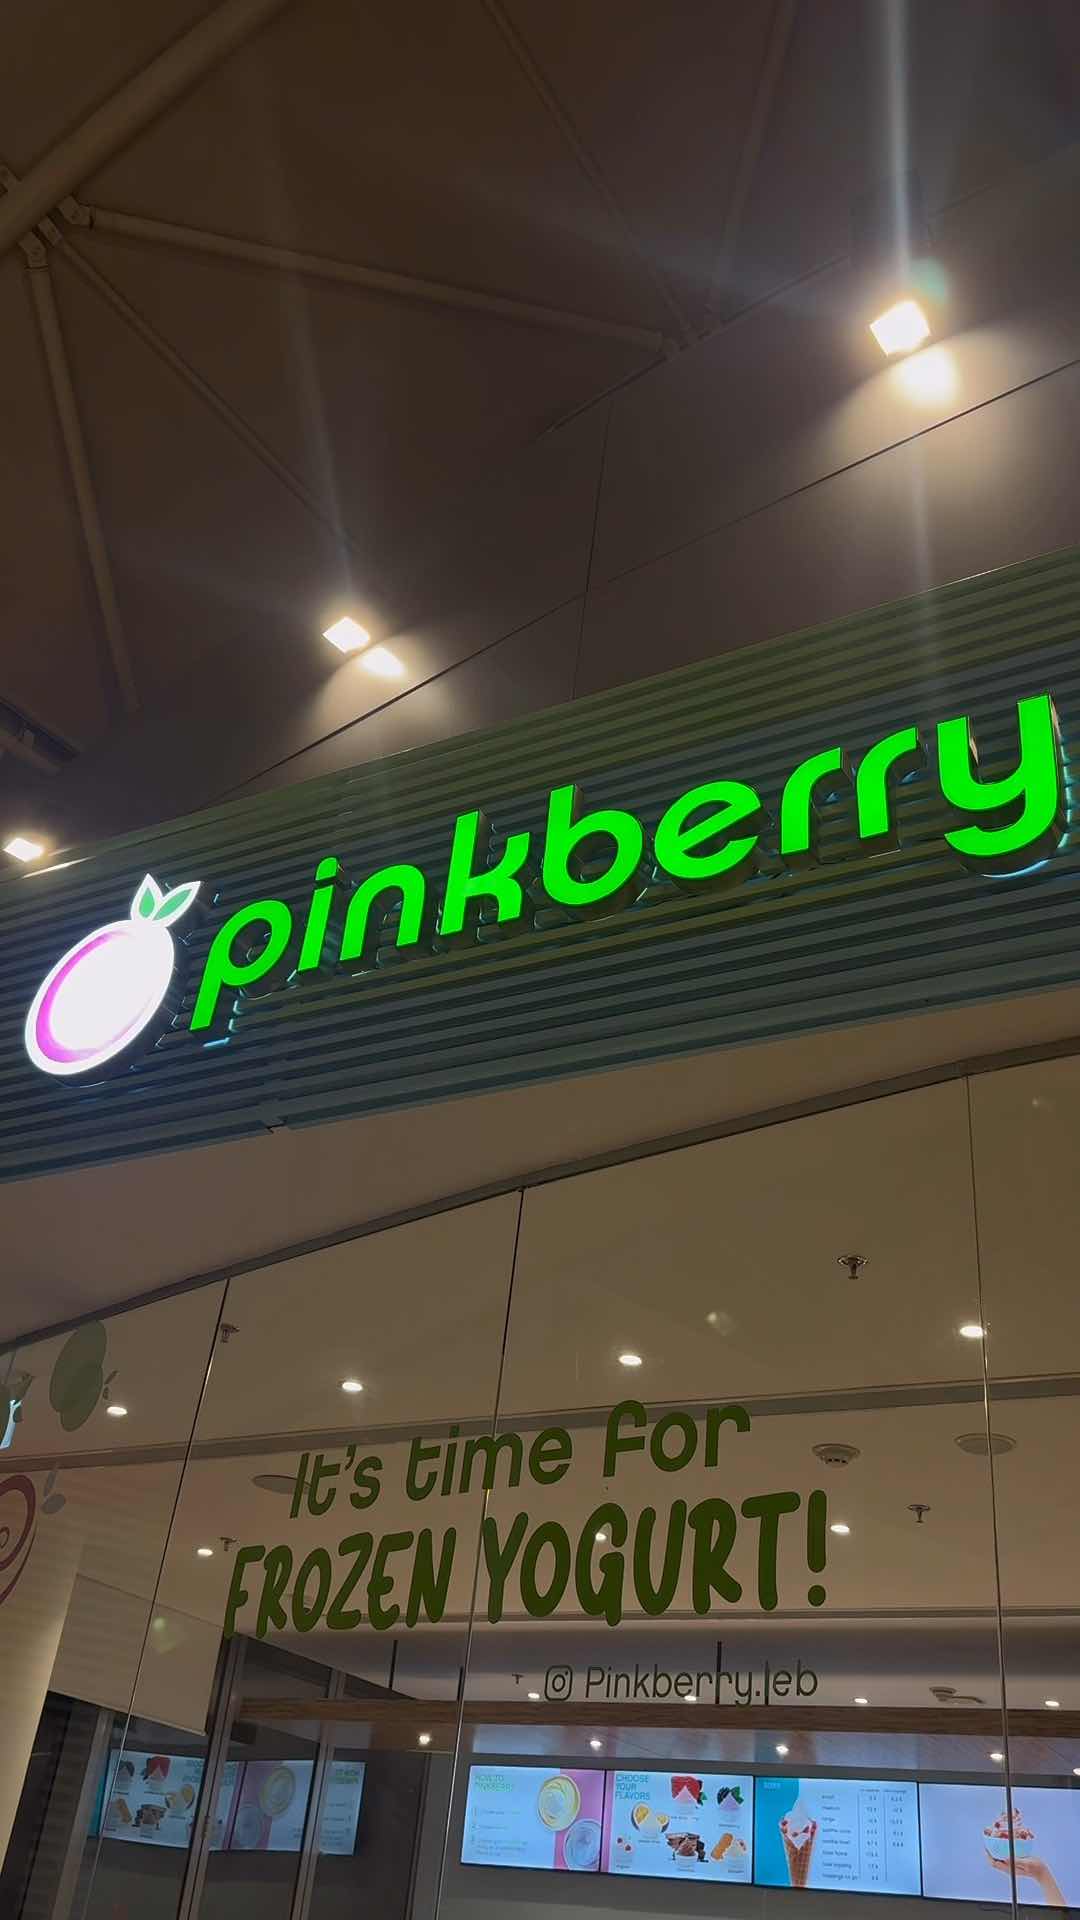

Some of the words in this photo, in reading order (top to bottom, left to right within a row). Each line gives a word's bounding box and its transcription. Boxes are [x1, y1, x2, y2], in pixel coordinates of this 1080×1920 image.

[190, 691, 1059, 1032] pinkberry
[289, 1444, 384, 1519] It's
[405, 1424, 573, 1501] time
[603, 1400, 752, 1477] for
[223, 1527, 457, 1639] FROZEN
[482, 1489, 828, 1627] YOGURT!
[585, 1659, 818, 1707] Pinkberry.leb
